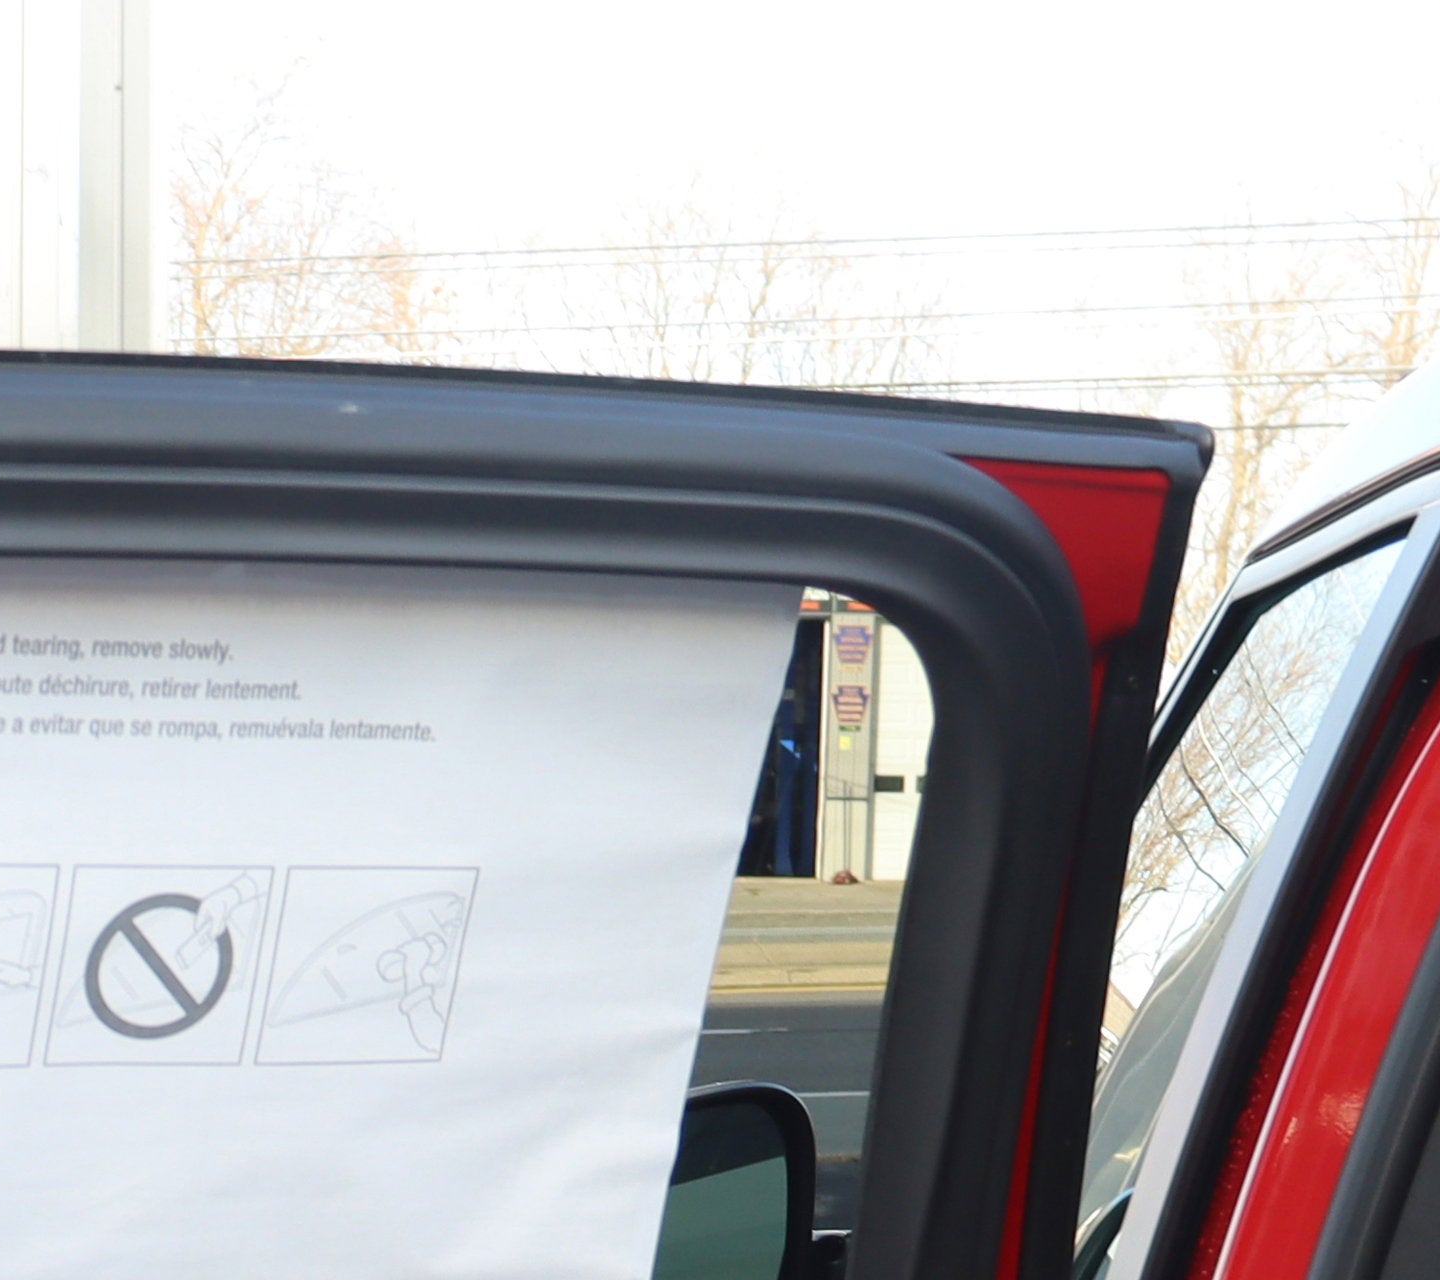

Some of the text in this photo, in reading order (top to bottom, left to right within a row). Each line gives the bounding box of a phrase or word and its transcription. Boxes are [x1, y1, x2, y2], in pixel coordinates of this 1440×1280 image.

[12, 634, 85, 661] tearing,
[91, 640, 163, 659] remove
[168, 638, 234, 665] slowly.
[38, 673, 135, 699] déchirure,
[141, 677, 200, 699] retirer
[205, 677, 301, 701] lentement.
[11, 717, 24, 734] a
[29, 714, 85, 735] evitar
[88, 717, 125, 739] que
[130, 720, 152, 737] se
[157, 720, 223, 742] rompa,
[229, 717, 324, 740] remuévala
[328, 718, 437, 743] lentamente.
